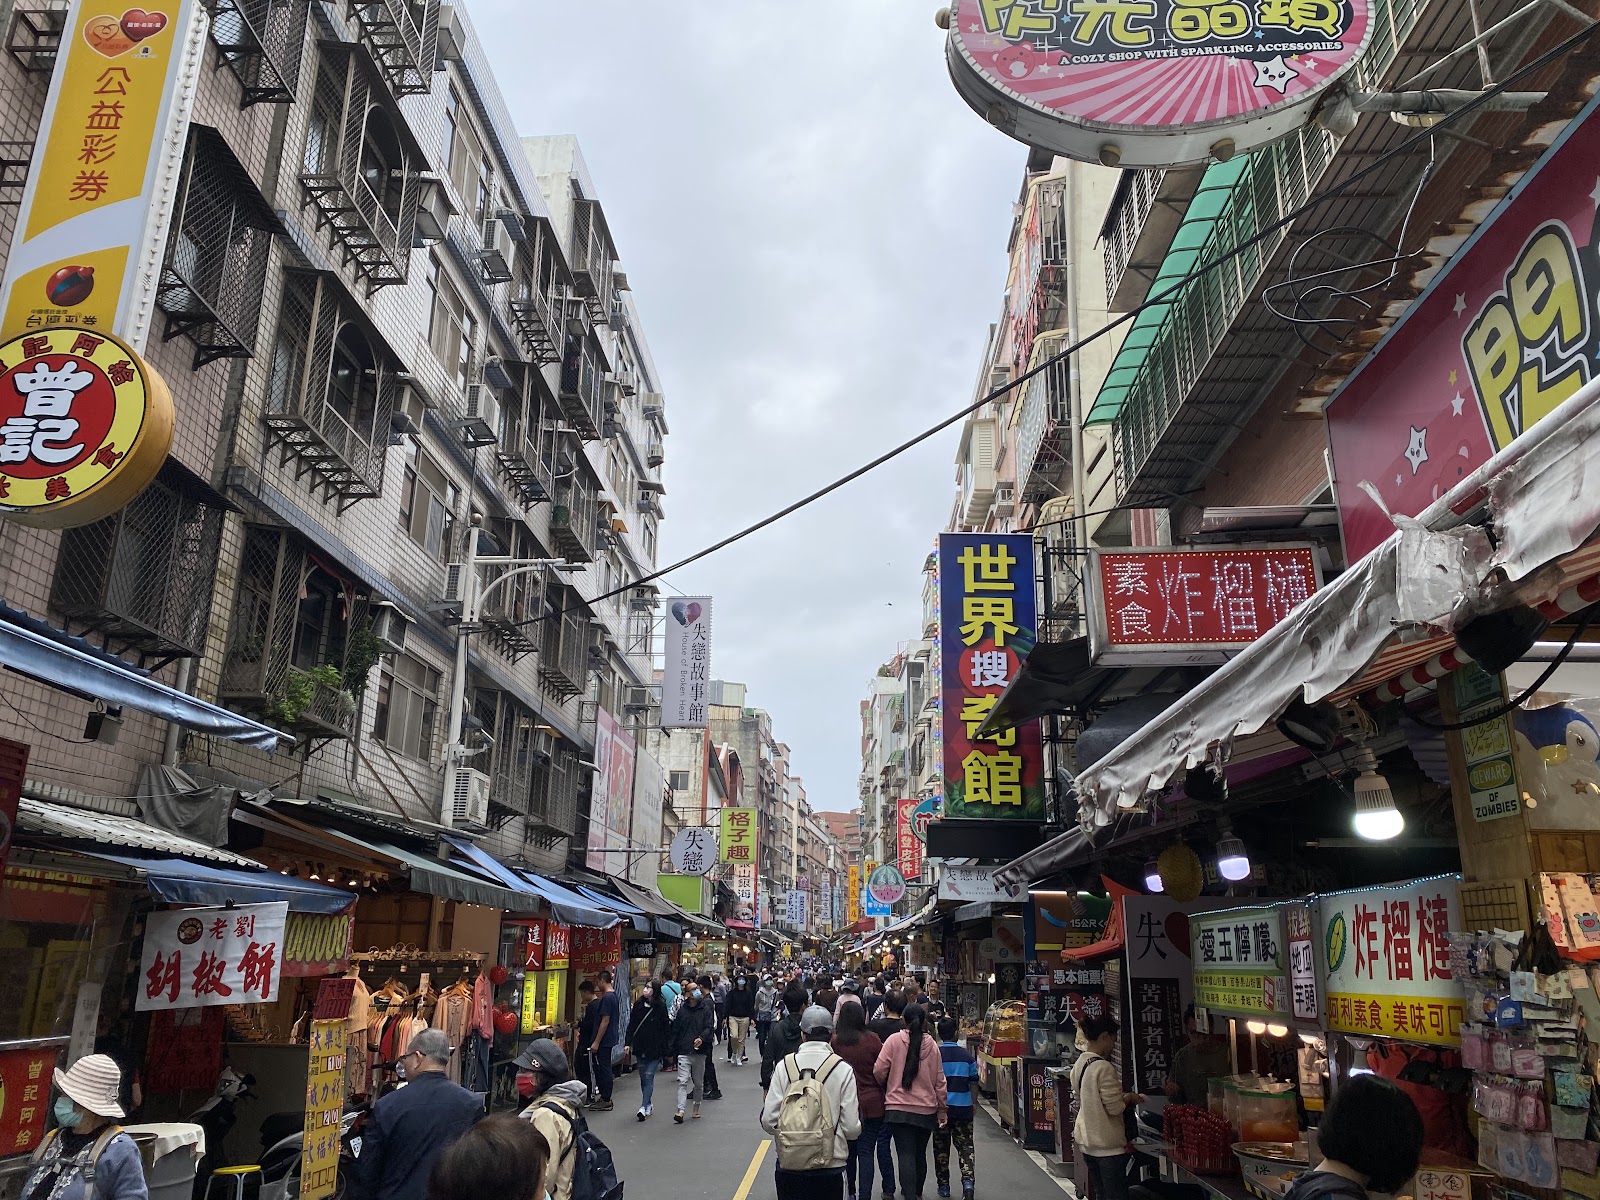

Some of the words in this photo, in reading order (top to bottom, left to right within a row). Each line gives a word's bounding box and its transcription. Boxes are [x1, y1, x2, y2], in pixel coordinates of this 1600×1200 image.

[1060, 56, 1071, 66] A
[1072, 53, 1106, 64] COZY
[1108, 50, 1142, 61] SHOP
[1144, 47, 1179, 59] WITH
[1181, 44, 1254, 57] SPARKLING
[1256, 41, 1343, 52] ACCESSORIES
[67, 65, 132, 202] 公益彩券
[0, 360, 95, 464] 曾記
[1112, 560, 1152, 636] 素食
[1156, 557, 1309, 635] 炸榴槤
[680, 631, 690, 656] House
[680, 659, 689, 667] of
[679, 670, 688, 697] Broken
[688, 622, 707, 723] 失戀故事館
[678, 700, 687, 722] Heart
[1472, 762, 1509, 785] BEWARE
[1475, 799, 1518, 818] ZOMBIES
[1488, 791, 1500, 803] OF
[682, 830, 704, 872] 失戀
[726, 811, 751, 860] 格子趣
[209, 914, 256, 940] 老劉
[1135, 911, 1167, 961] 失
[1199, 921, 1273, 964] 愛玉檸檬
[1287, 908, 1312, 938] 拔絲
[1352, 893, 1453, 982] 炸榴槤
[525, 923, 542, 967] 達人
[1292, 944, 1313, 974] 地瓜
[146, 941, 276, 1004] 胡椒餅
[1294, 982, 1316, 1013] 芋頭
[1138, 983, 1168, 1090] 苦命者免費
[14, 1059, 43, 1148] 曾記阿給
[1032, 1087, 1044, 1111] 門票
